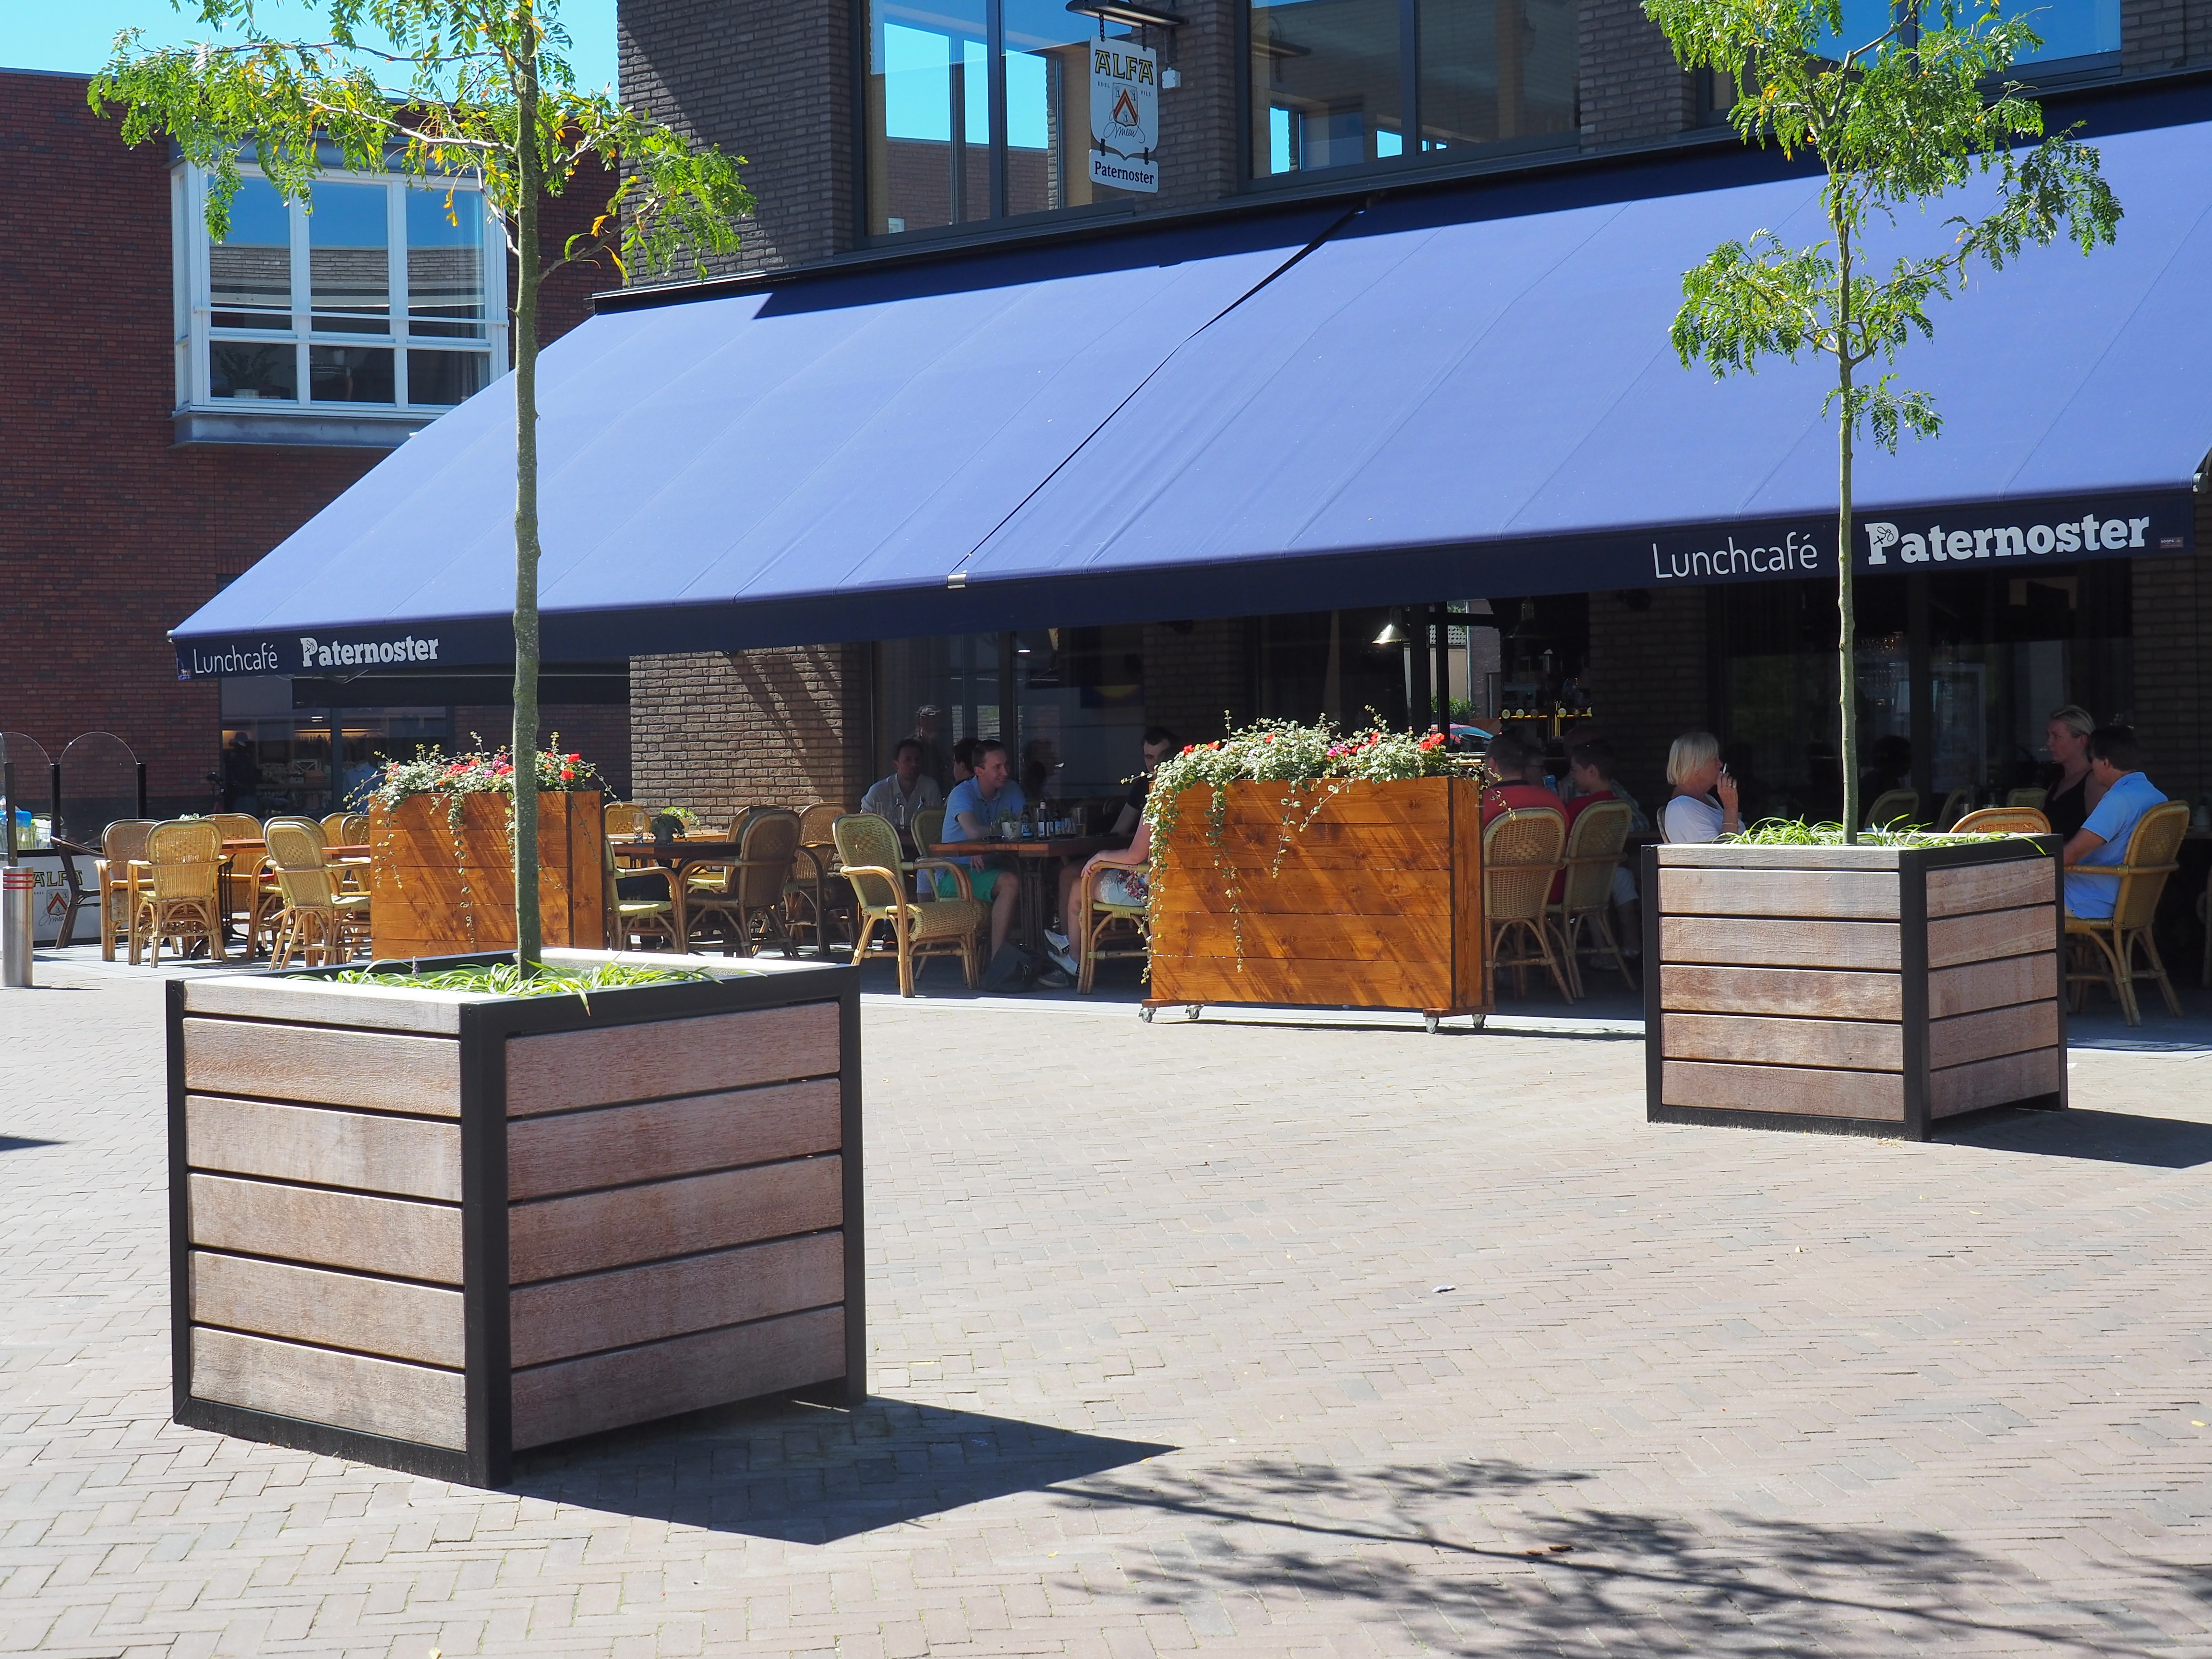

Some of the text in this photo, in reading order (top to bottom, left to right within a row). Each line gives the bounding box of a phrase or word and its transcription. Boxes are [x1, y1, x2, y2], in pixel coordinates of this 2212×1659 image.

[1095, 49, 1154, 85] ALFA
[1094, 161, 1154, 184] Paternoster
[1652, 514, 2149, 579] Lunchcafé Paternoster
[193, 635, 439, 674] Lunchcafé Paternoster
